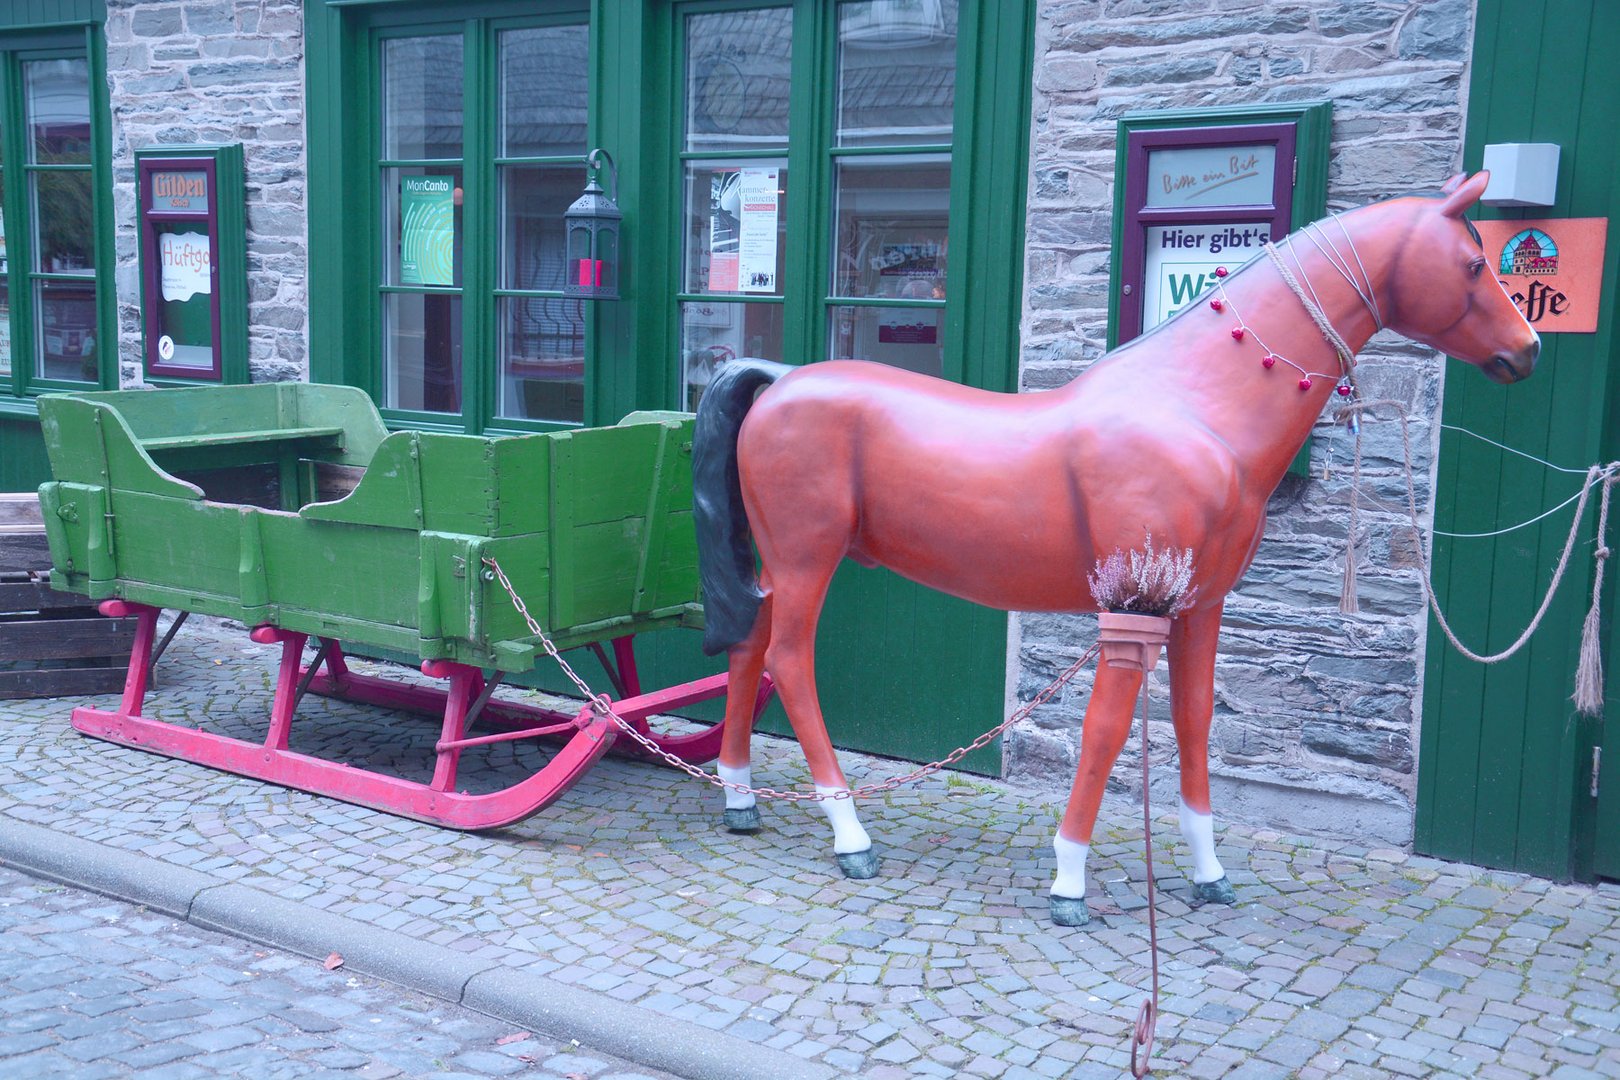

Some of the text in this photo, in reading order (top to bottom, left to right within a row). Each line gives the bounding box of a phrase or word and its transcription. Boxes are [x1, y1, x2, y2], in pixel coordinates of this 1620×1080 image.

[155, 173, 205, 197] Gilden
[406, 180, 449, 191] MonCanto
[1163, 154, 1260, 194] Bitte ein Bit
[1162, 228, 1269, 253] Hier gibt's
[1499, 280, 1571, 322] effe
